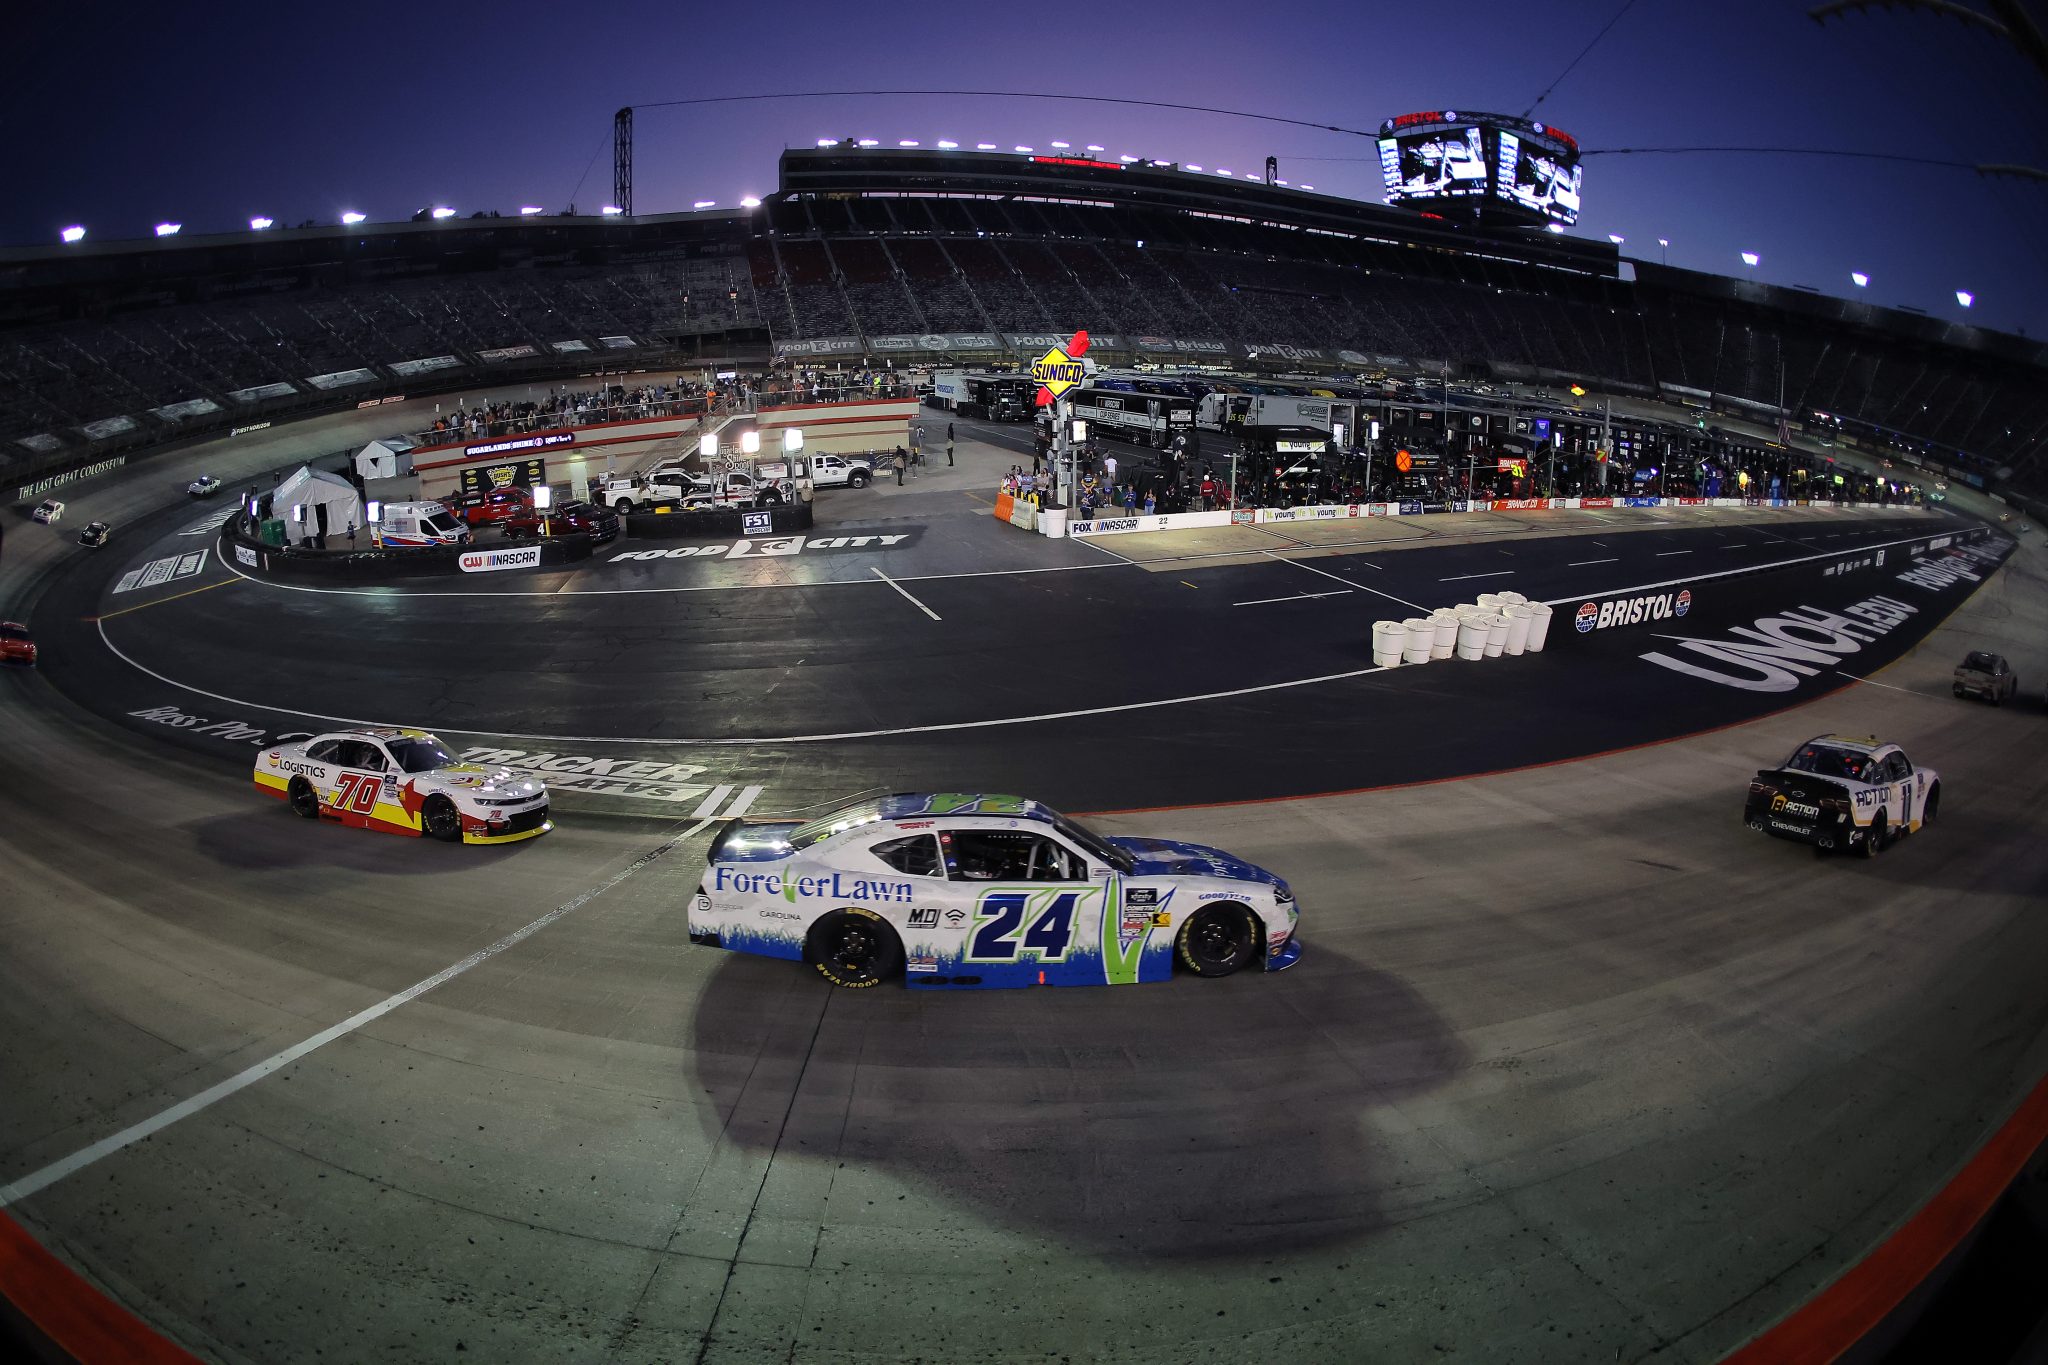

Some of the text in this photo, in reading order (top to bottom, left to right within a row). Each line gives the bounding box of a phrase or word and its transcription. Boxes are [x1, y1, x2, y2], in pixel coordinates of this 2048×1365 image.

[1395, 111, 1441, 126] BRISTOL
[778, 341, 855, 352] FOOD CITY
[1174, 340, 1226, 350] Bristol
[1033, 363, 1081, 383] SUNOCO
[1104, 400, 1120, 410] NASCAR
[1108, 412, 1121, 421] SERIES
[236, 422, 271, 435] FIRST HORIZON
[466, 443, 511, 455] SUGARLANDS
[512, 439, 535, 450] SHINE
[18, 456, 126, 499] THE LAST GREAT COLOSSEUM
[493, 471, 512, 480] BUSH'S
[1511, 464, 1524, 478] 31
[508, 504, 523, 512] Ford
[1455, 502, 1463, 510] 31
[745, 514, 770, 528] FS1
[1073, 519, 1138, 533] FOX NASCAR
[1158, 517, 1168, 525] 22
[537, 523, 545, 535] 4
[606, 534, 910, 563] FOOD CITY
[463, 551, 536, 568] CW NASCAR
[1596, 593, 1674, 630] BRISTOL
[1638, 595, 1919, 693] UNOH.EDU
[127, 706, 209, 728] Bass
[189, 721, 267, 740] Pro
[279, 759, 326, 779] LOGISTICS
[459, 746, 709, 783] TRACKER
[332, 770, 385, 816] 70
[1855, 786, 1892, 807] ACTION
[489, 809, 503, 818] 70
[1785, 801, 1820, 815] ACTION
[1771, 820, 1812, 836] CHEVROLET
[715, 863, 914, 904] ForeverLawn
[1198, 892, 1252, 902] GOODYEAR
[759, 909, 802, 922] CAROLINA
[970, 890, 1080, 963] 24
